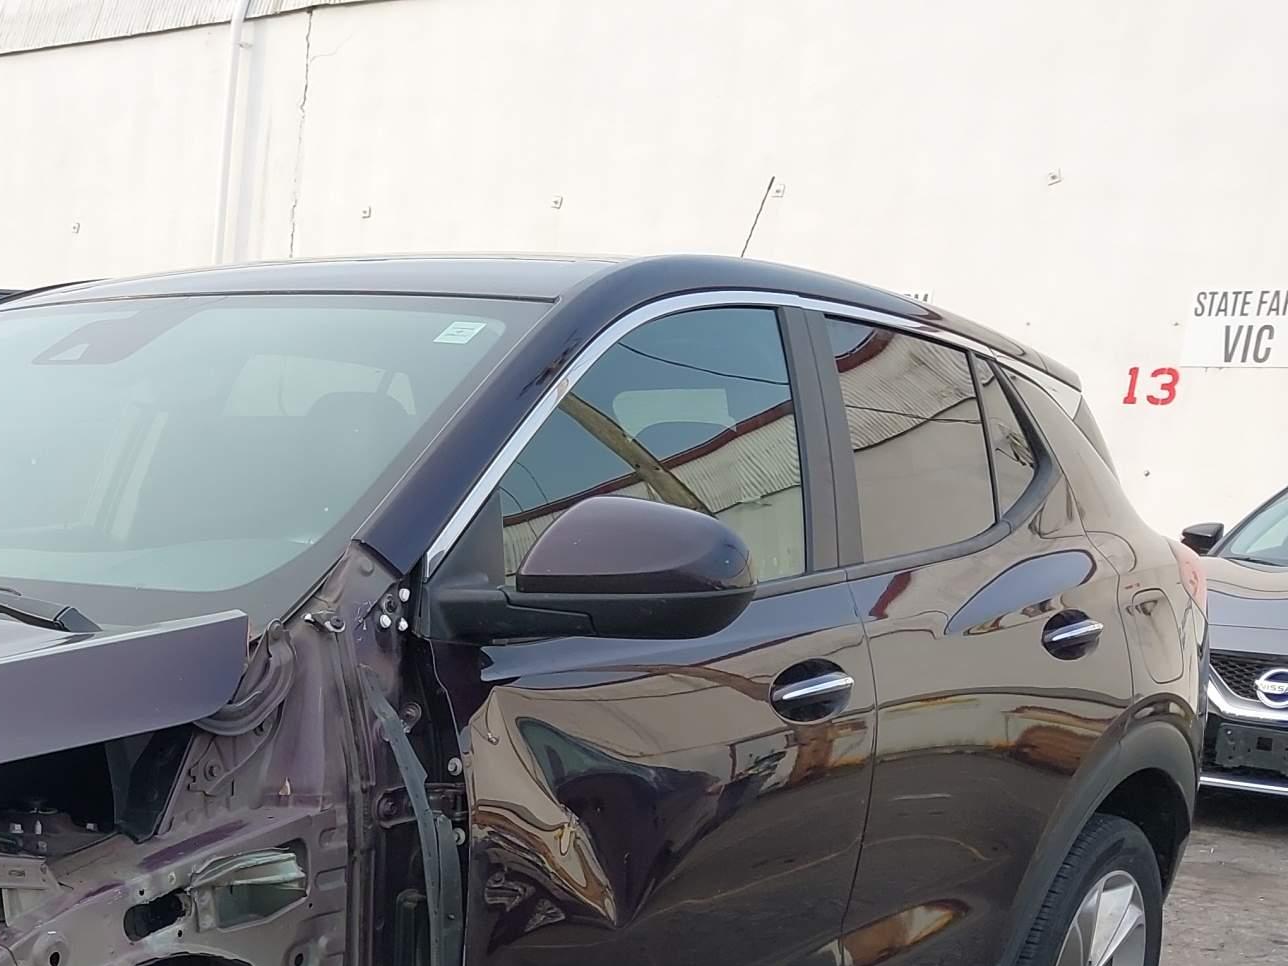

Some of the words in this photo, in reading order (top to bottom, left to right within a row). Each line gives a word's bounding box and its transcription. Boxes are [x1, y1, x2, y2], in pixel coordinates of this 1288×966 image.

[1194, 291, 1253, 317] STATE
[1224, 324, 1275, 363] VIC
[1123, 366, 1180, 406] 13
